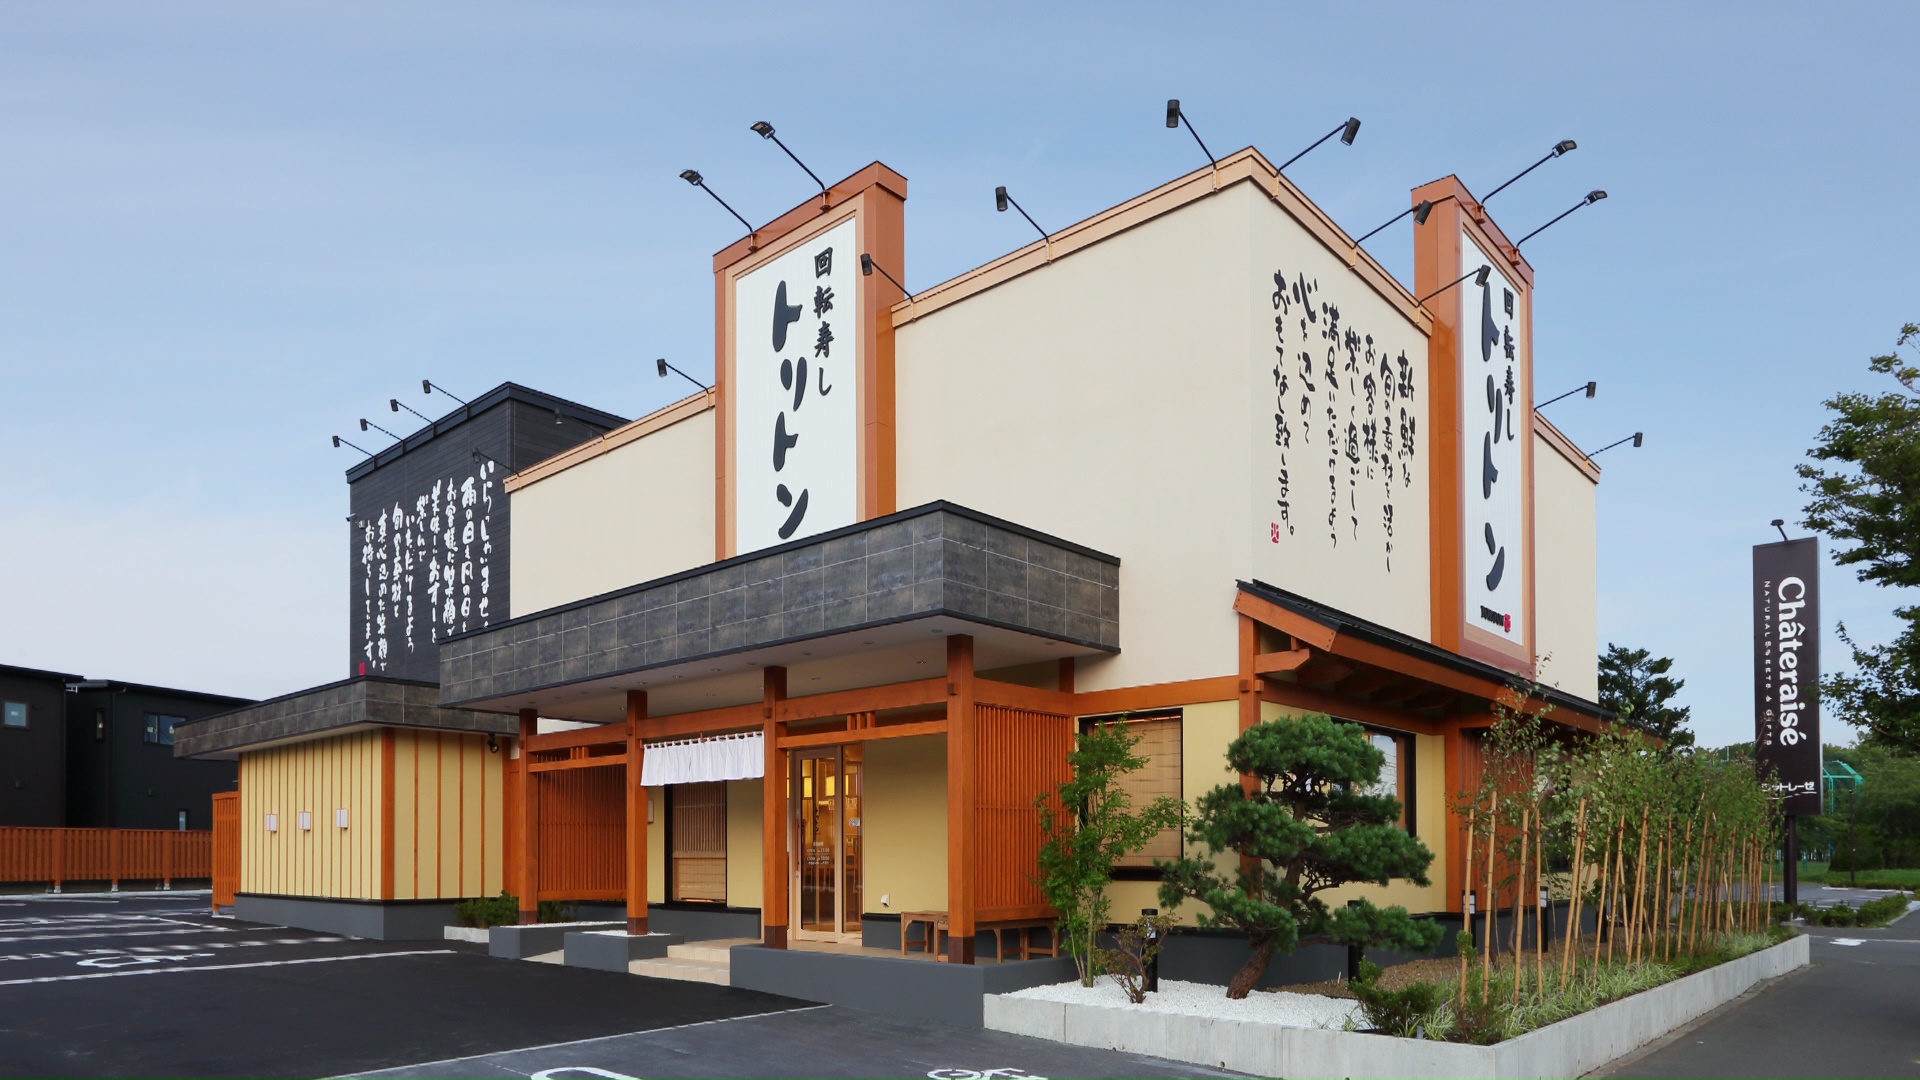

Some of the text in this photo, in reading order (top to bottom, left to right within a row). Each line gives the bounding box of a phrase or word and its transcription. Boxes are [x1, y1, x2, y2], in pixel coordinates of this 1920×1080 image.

[814, 247, 835, 396] 回転寿し
[1503, 287, 1516, 441] 回転寿し
[772, 280, 808, 540] トリトン
[1481, 281, 1505, 591] トリトン
[1778, 576, 1807, 746] Châteraisé
